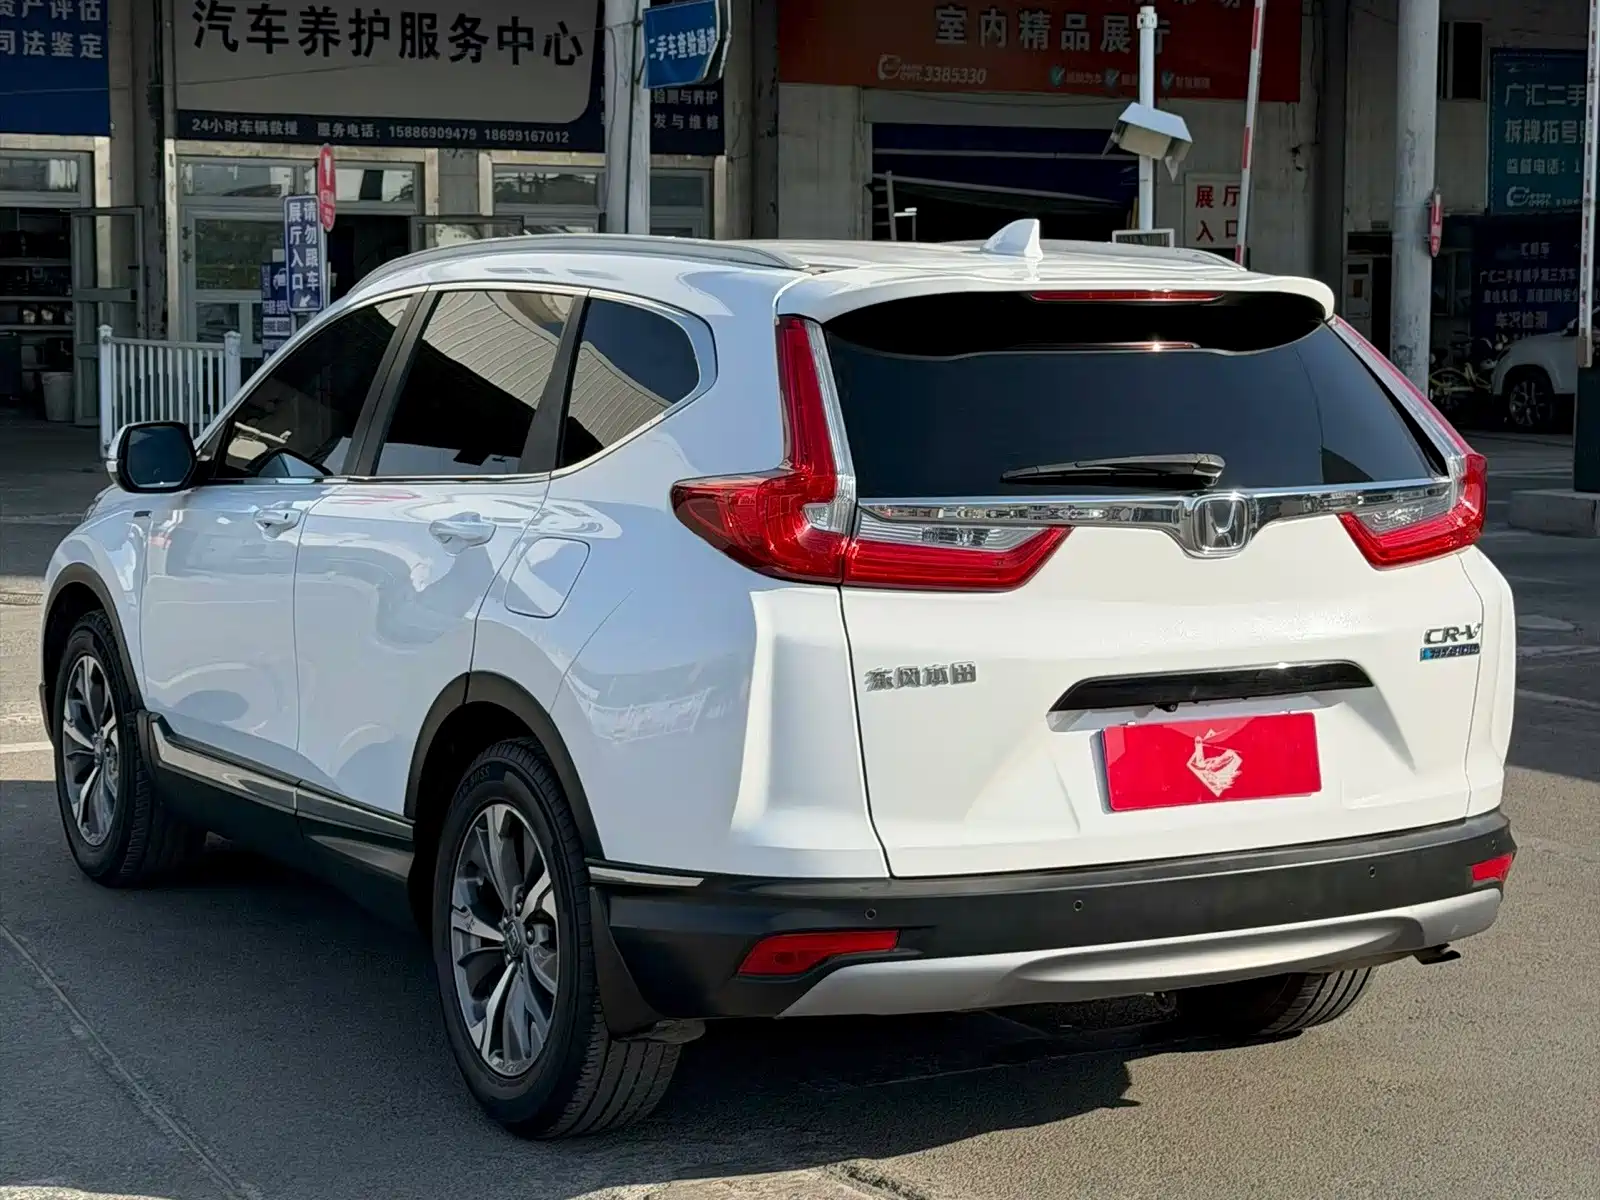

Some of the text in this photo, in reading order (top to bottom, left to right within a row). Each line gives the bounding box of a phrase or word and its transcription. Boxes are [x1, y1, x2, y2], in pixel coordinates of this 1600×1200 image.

[0, 29, 104, 59] 司法鉴定
[192, 0, 584, 66] 汽车养护服务中心
[191, 118, 299, 137] 24小时车辆救援
[388, 125, 477, 140] 15886909479
[484, 128, 570, 143] 18699167012
[1195, 184, 1241, 209] 展厅
[288, 201, 304, 291] 展厅入口
[303, 200, 320, 292] 请勿跟车
[1196, 219, 1239, 243] 入口
[1424, 622, 1483, 645] CR-V
[864, 660, 978, 692] 东风本田
